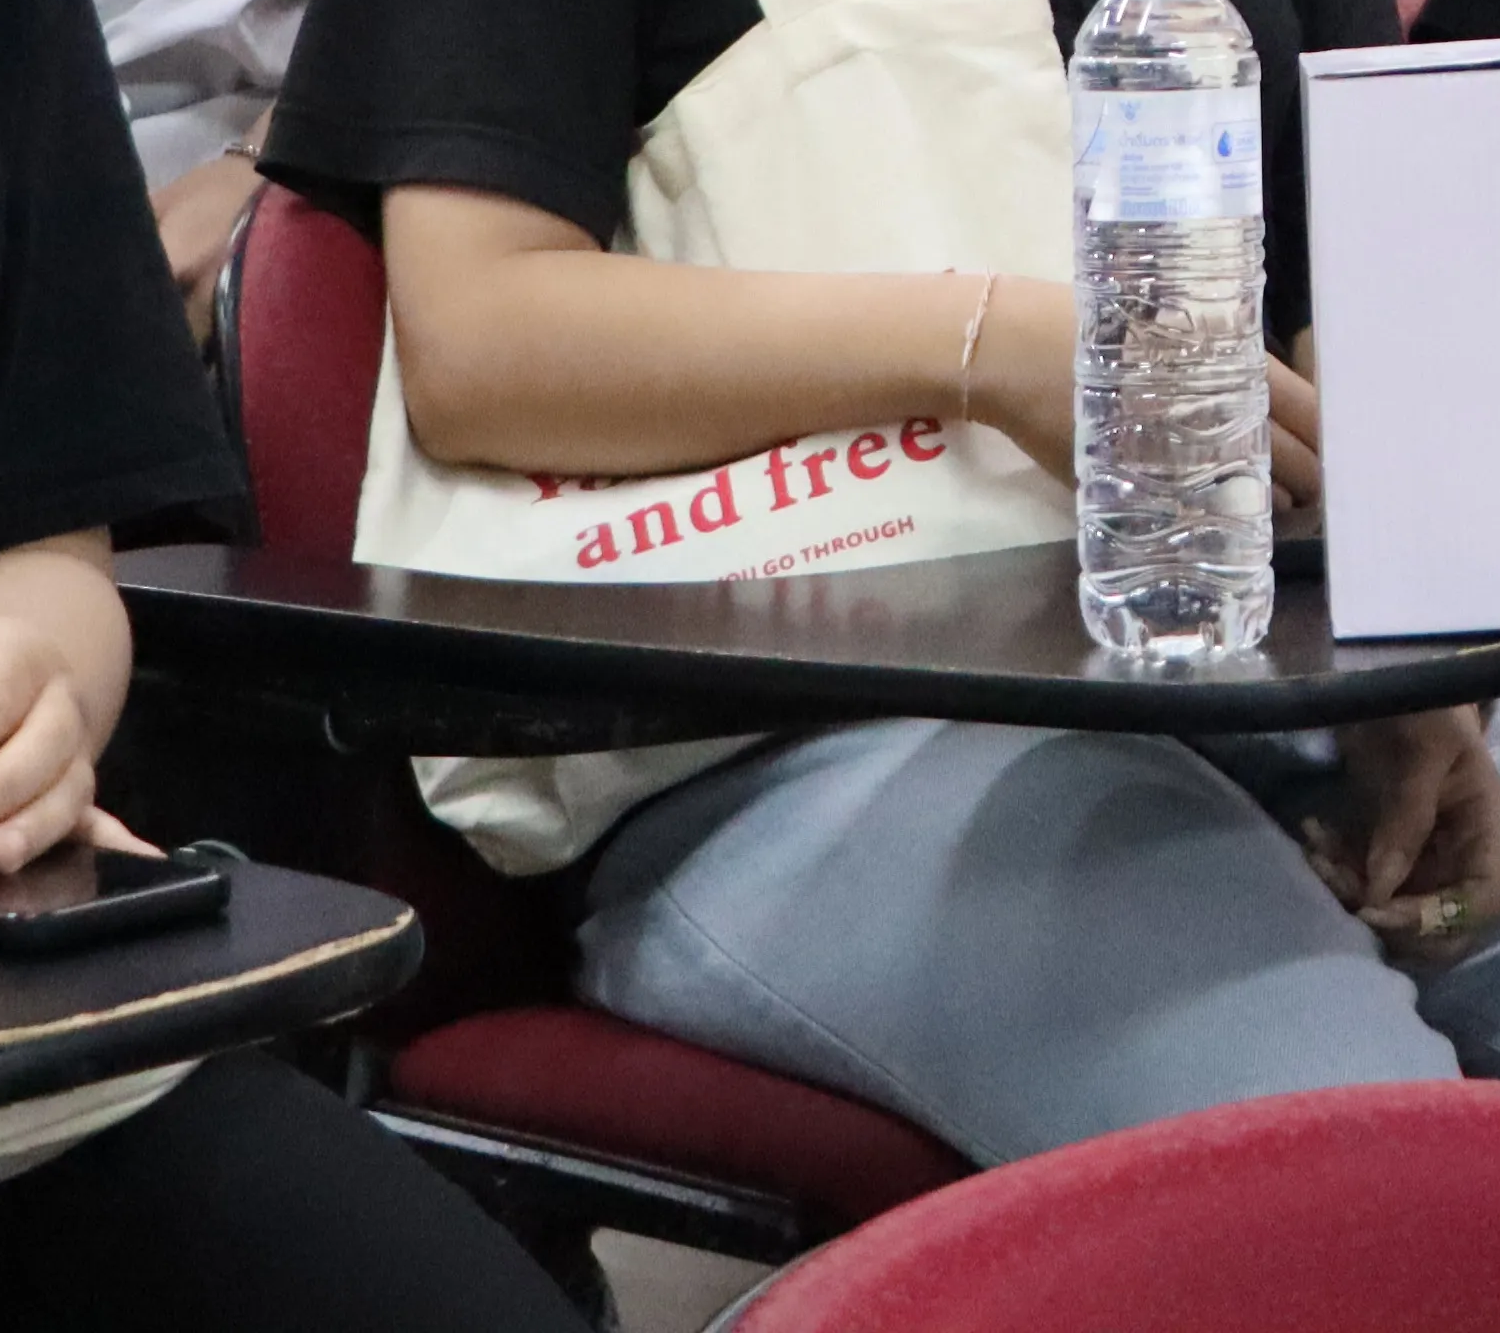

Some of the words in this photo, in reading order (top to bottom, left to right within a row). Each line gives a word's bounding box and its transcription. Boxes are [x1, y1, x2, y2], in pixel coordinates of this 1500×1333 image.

[575, 464, 742, 571] and
[762, 416, 947, 514] free
[763, 553, 796, 577] GO
[800, 515, 915, 565] THROUGH
